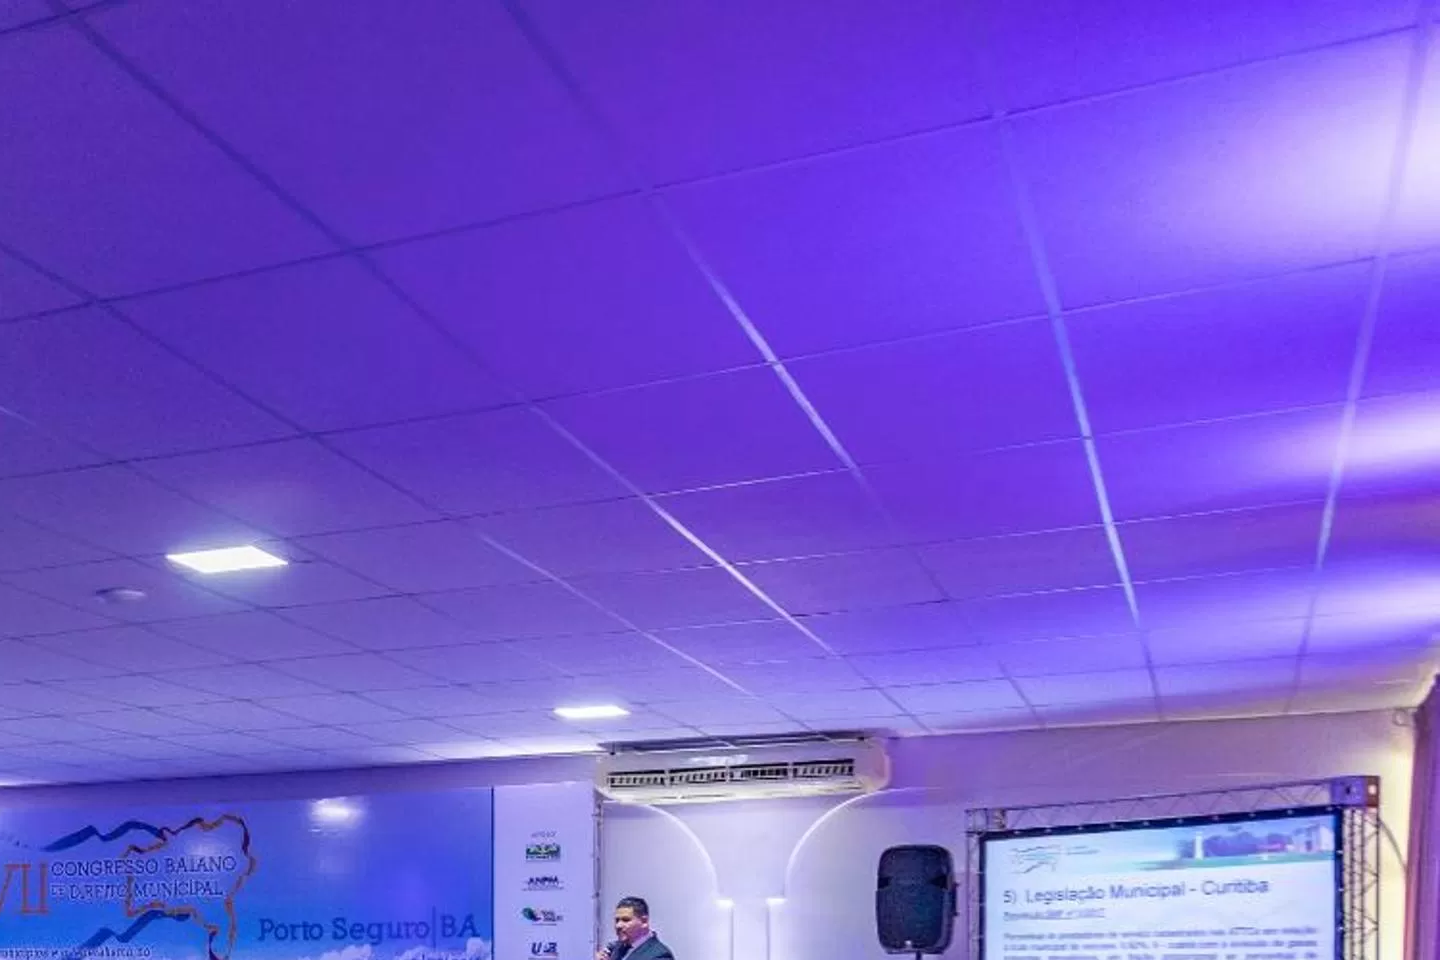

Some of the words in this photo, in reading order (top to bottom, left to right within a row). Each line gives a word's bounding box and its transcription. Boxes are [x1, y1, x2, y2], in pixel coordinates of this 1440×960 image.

[51, 858, 158, 877] CONGRESSO
[165, 856, 237, 874] BAIANO
[133, 878, 224, 899] MUNICIPAL
[1110, 881, 1185, 899] Municipal
[1201, 879, 1269, 895] Curitiba
[258, 917, 323, 941] Porto
